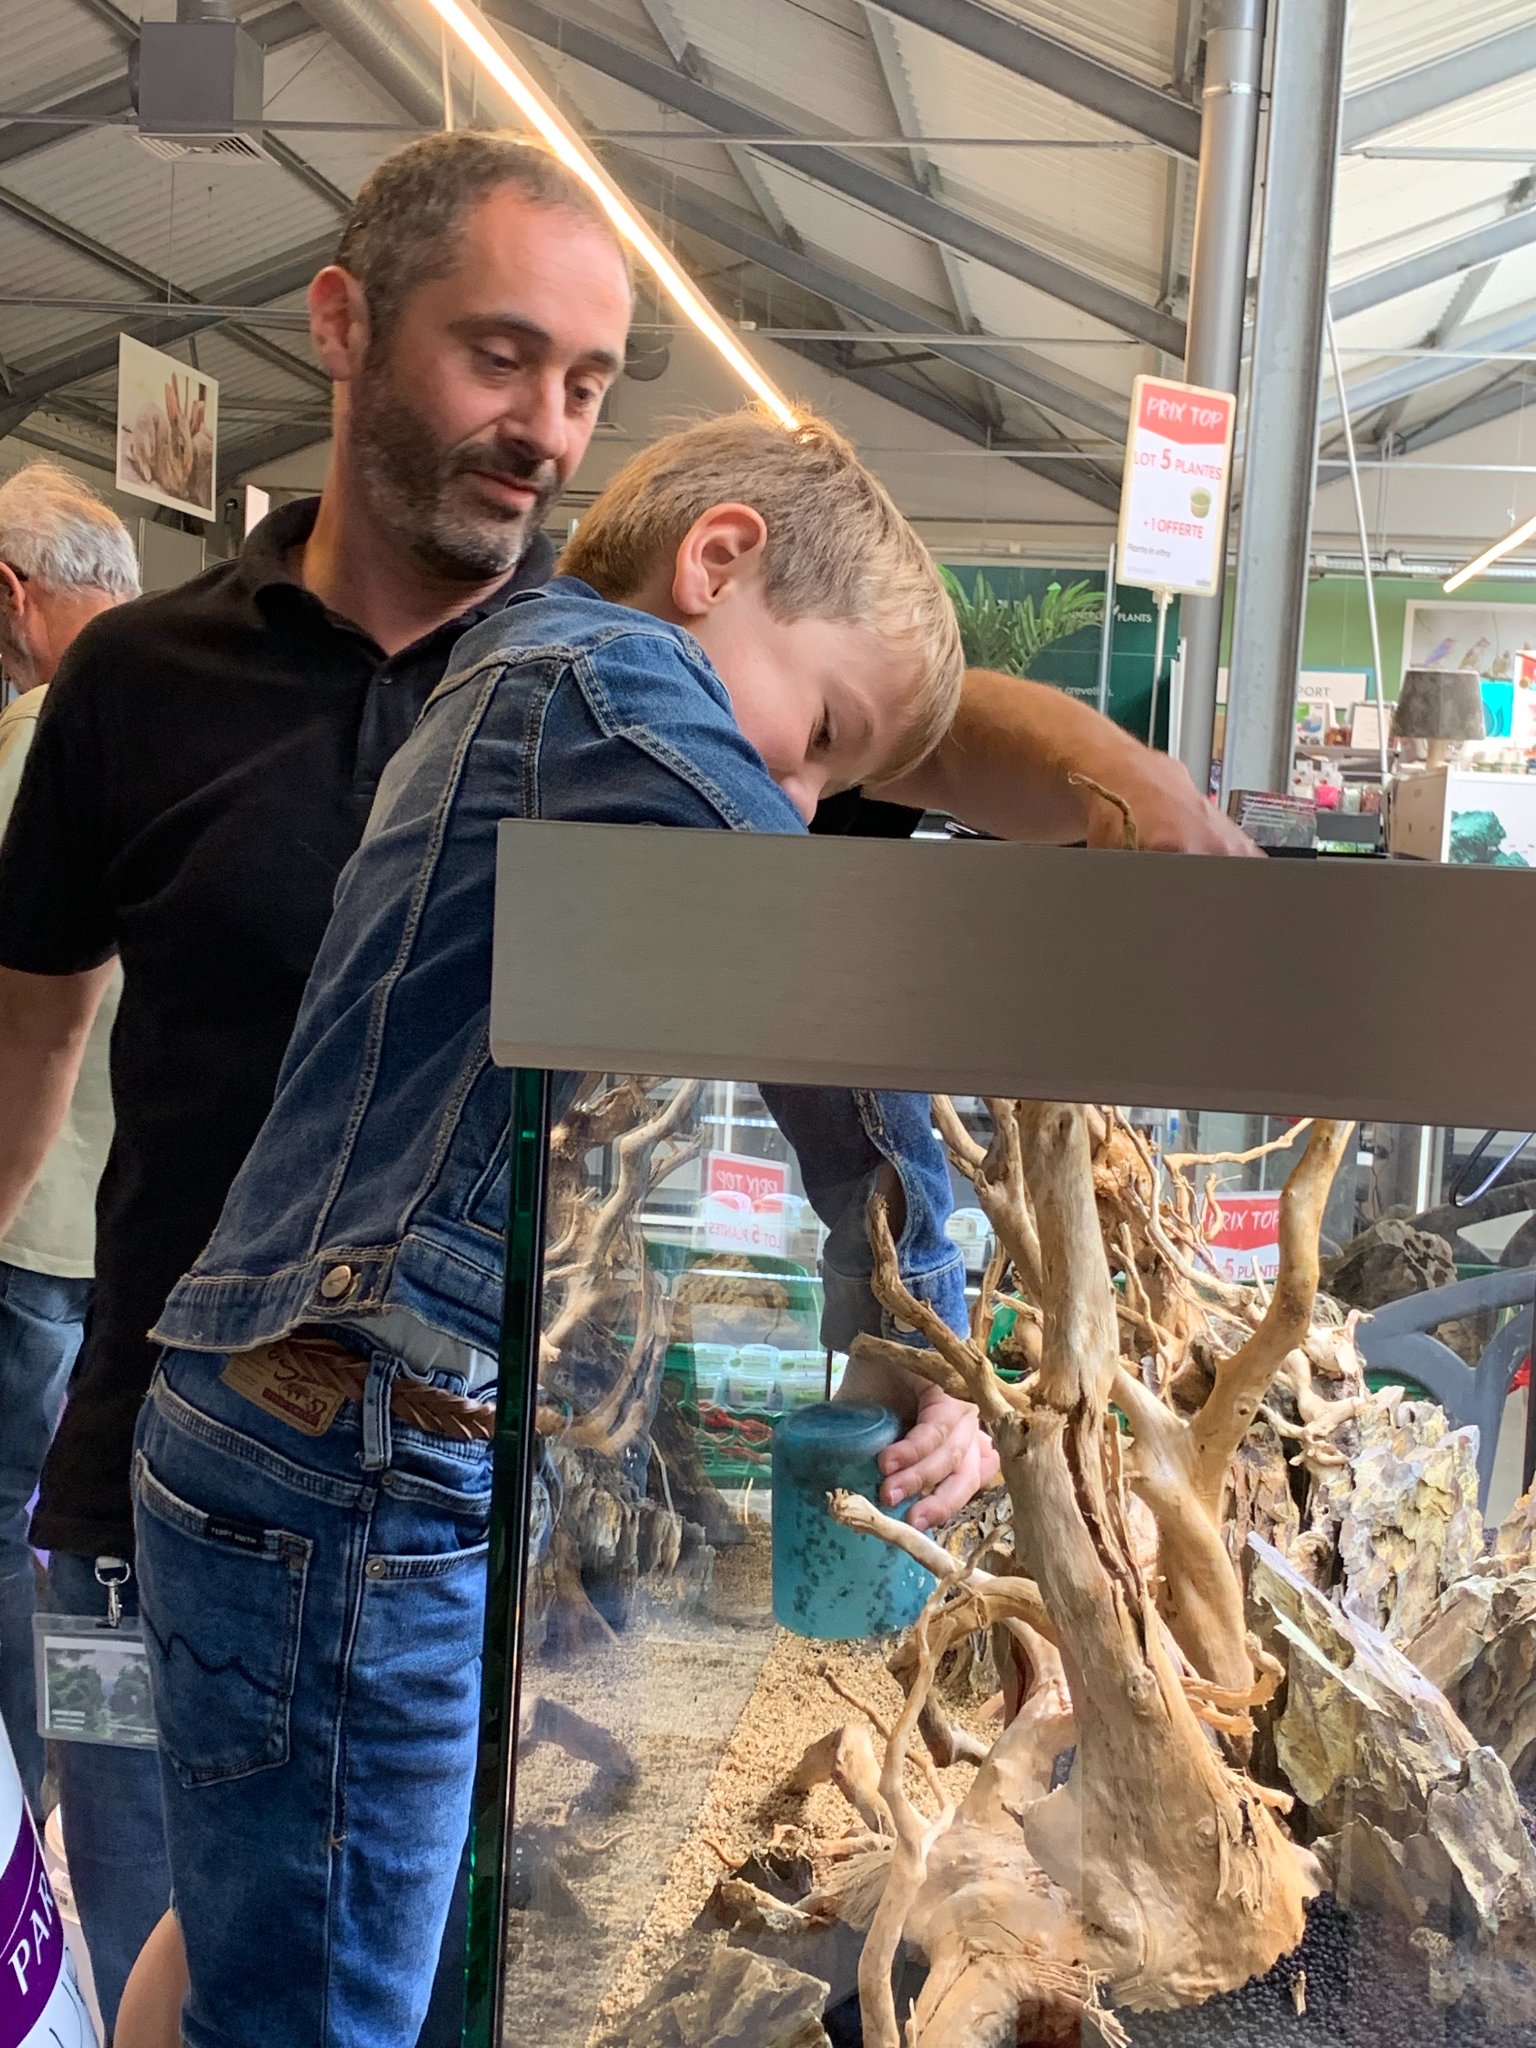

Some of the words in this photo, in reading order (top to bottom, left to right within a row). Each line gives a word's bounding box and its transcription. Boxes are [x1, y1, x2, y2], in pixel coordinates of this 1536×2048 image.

[1146, 396, 1187, 423] PRIX
[1190, 406, 1224, 430] TOP
[1160, 448, 1172, 470] 5
[1175, 458, 1222, 480] PLANTES
[1157, 519, 1204, 539] OFFERTE
[1117, 613, 1152, 623] PLANTS
